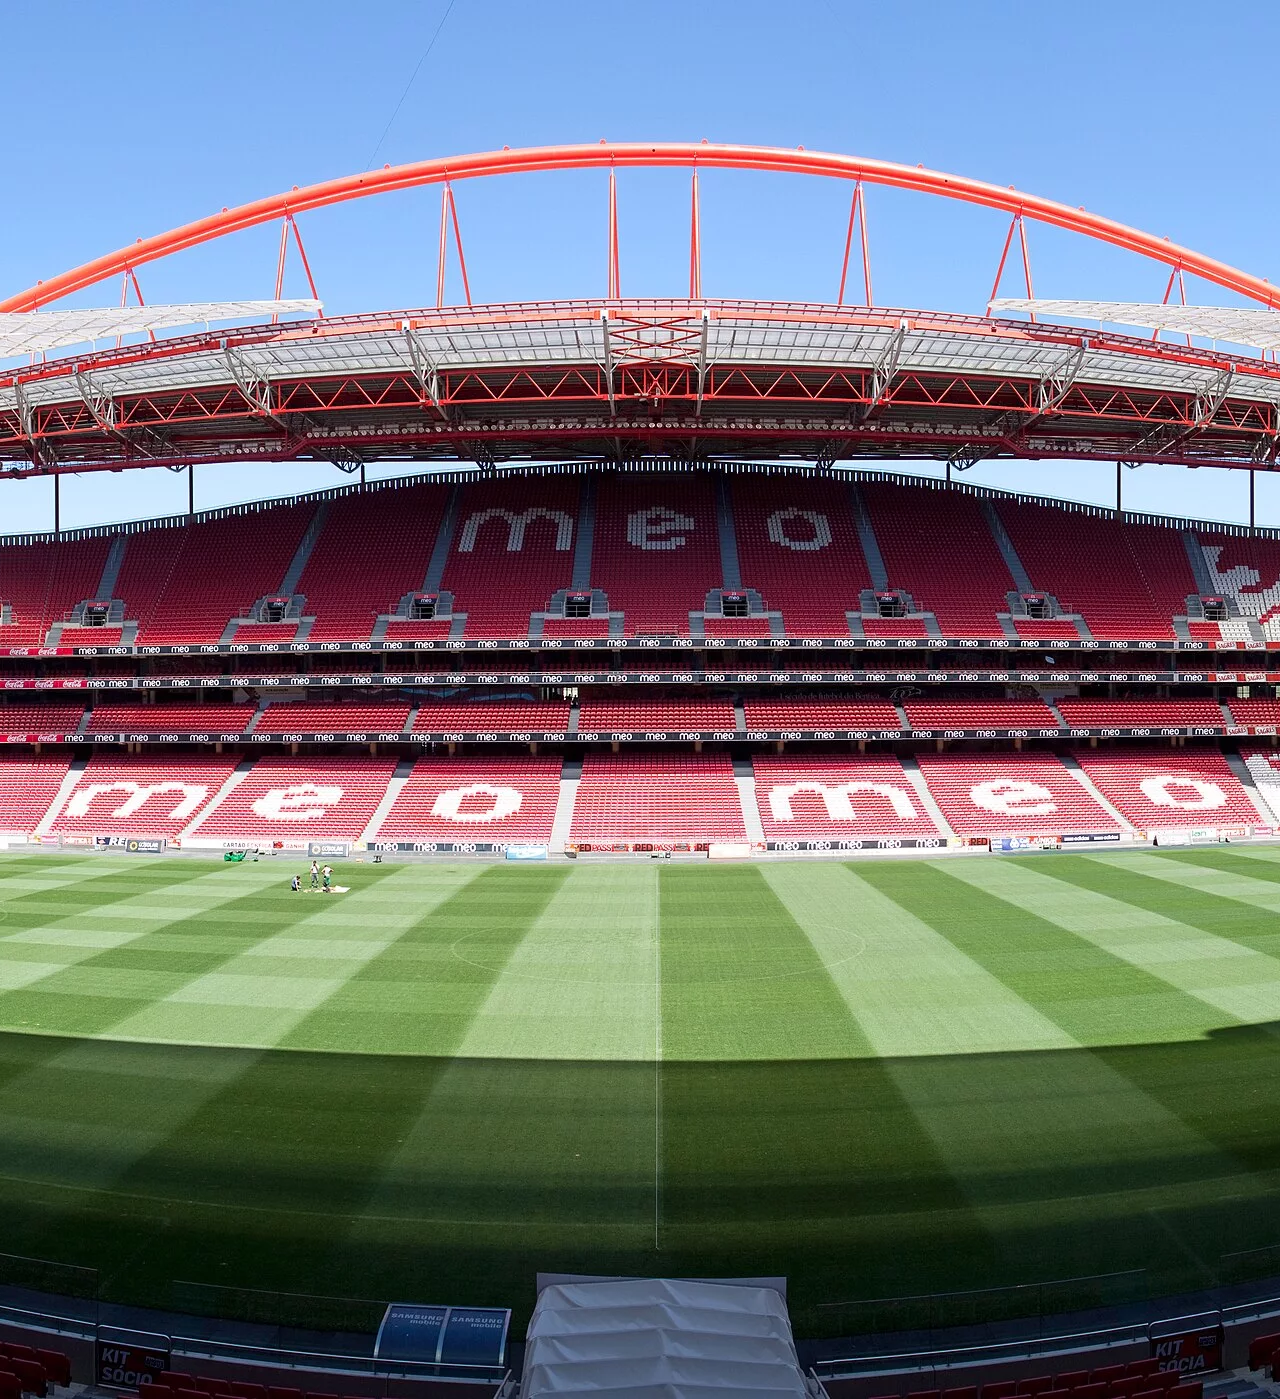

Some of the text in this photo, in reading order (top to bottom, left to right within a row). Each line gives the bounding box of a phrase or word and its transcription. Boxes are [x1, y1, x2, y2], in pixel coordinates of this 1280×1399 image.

[458, 506, 834, 553] meo
[446, 639, 466, 649] meo
[542, 638, 562, 648] meo
[770, 637, 790, 647] meo
[897, 638, 917, 648] meo
[1183, 641, 1203, 650] meo
[78, 646, 97, 655] meo
[230, 643, 248, 653] meo
[230, 677, 249, 686] meo
[640, 673, 660, 683] meo
[64, 734, 83, 742] meo
[476, 732, 497, 741] meo
[814, 731, 835, 740] meo
[62, 781, 523, 823] meo
[768, 775, 1227, 821] meo
[775, 840, 799, 850] meo
[806, 840, 831, 850] meo
[838, 840, 863, 849] meo
[877, 839, 901, 849] meo
[915, 838, 940, 848] meo
[971, 837, 988, 846] RED
[375, 842, 399, 852] meo
[413, 842, 437, 852] meo
[452, 843, 476, 852] meo
[592, 843, 611, 851] PASS
[635, 843, 653, 851] RED
[654, 843, 673, 851] PASS
[391, 1312, 443, 1322] SAMSUNG
[451, 1315, 504, 1325] SAMSUNG
[409, 1318, 441, 1327] mobile
[470, 1321, 503, 1331] mobile
[1156, 1339, 1185, 1358] KIT
[102, 1346, 131, 1365] KIT
[1158, 1355, 1206, 1373] SÓCIA
[102, 1364, 153, 1386] SÓCIO
